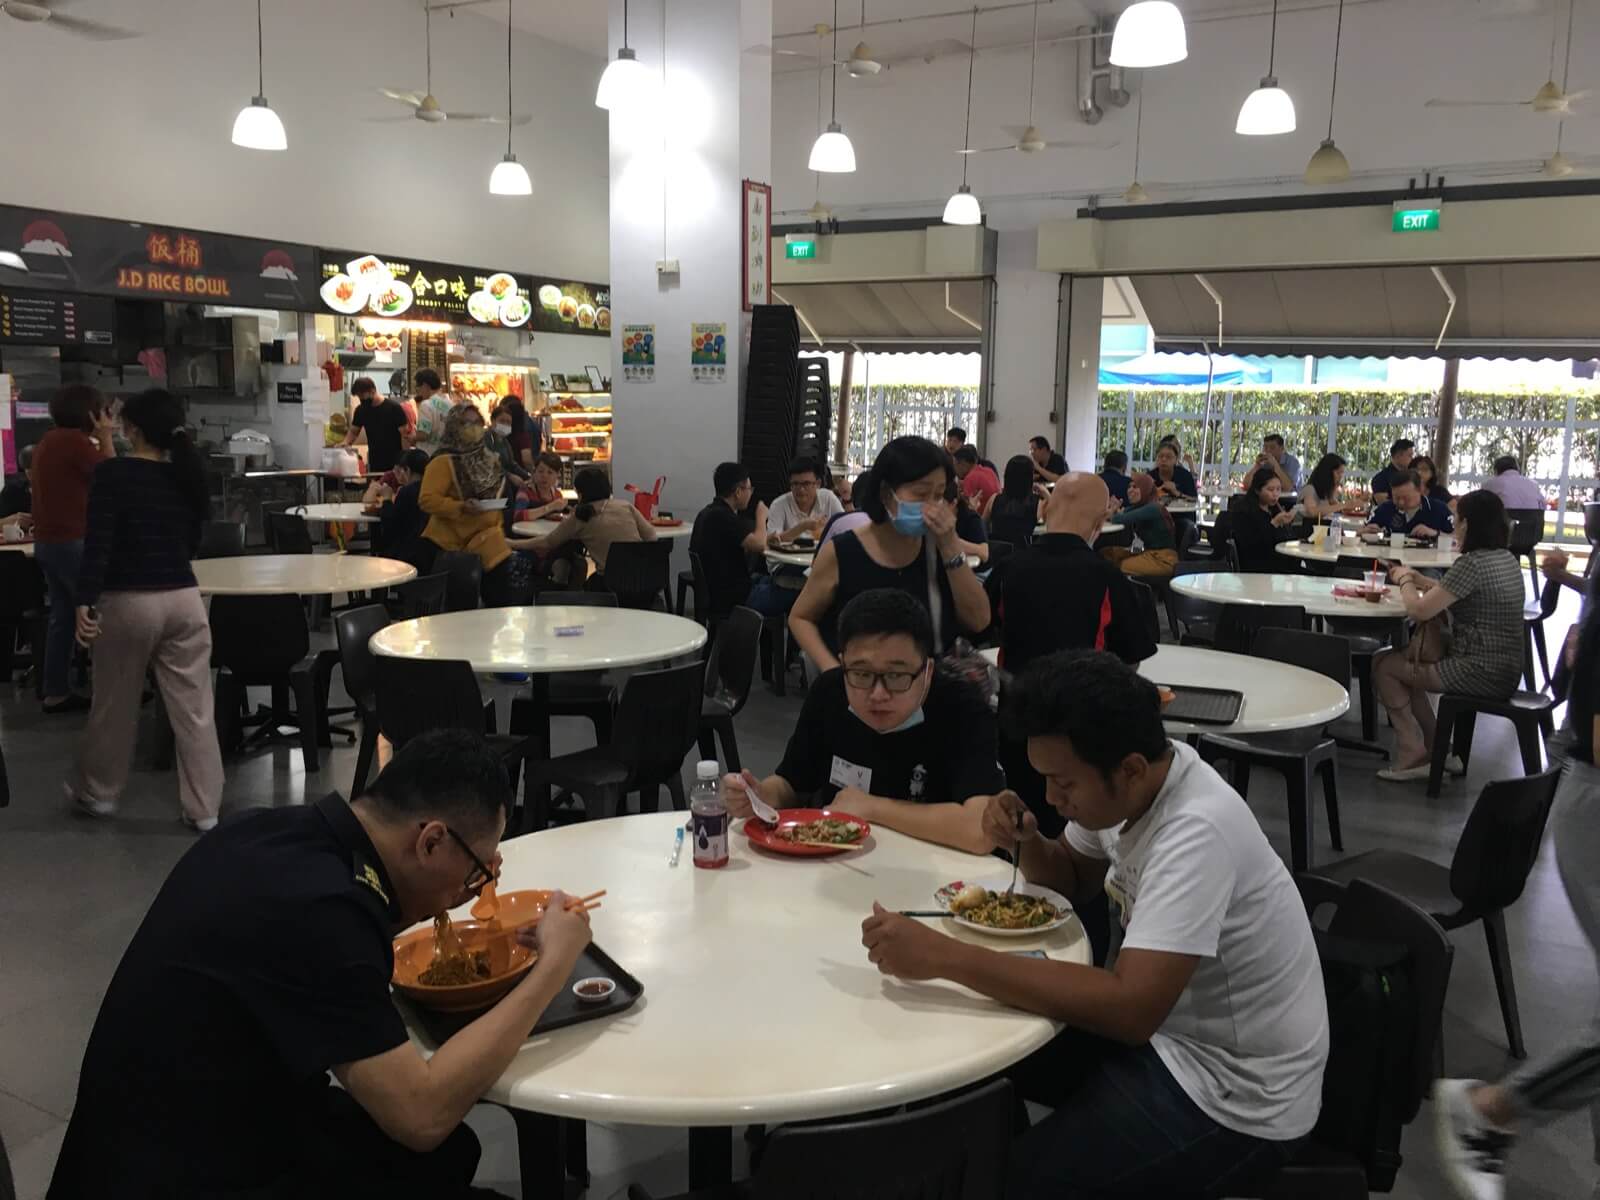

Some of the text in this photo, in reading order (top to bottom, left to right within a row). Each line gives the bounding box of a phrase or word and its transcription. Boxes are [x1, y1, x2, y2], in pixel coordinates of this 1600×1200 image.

[1402, 215, 1428, 228] EXIT
[148, 233, 200, 266] 饭桶
[792, 245, 809, 257] EXIT
[117, 269, 230, 296] J.D RICE BOWL
[411, 269, 471, 301] 合口味
